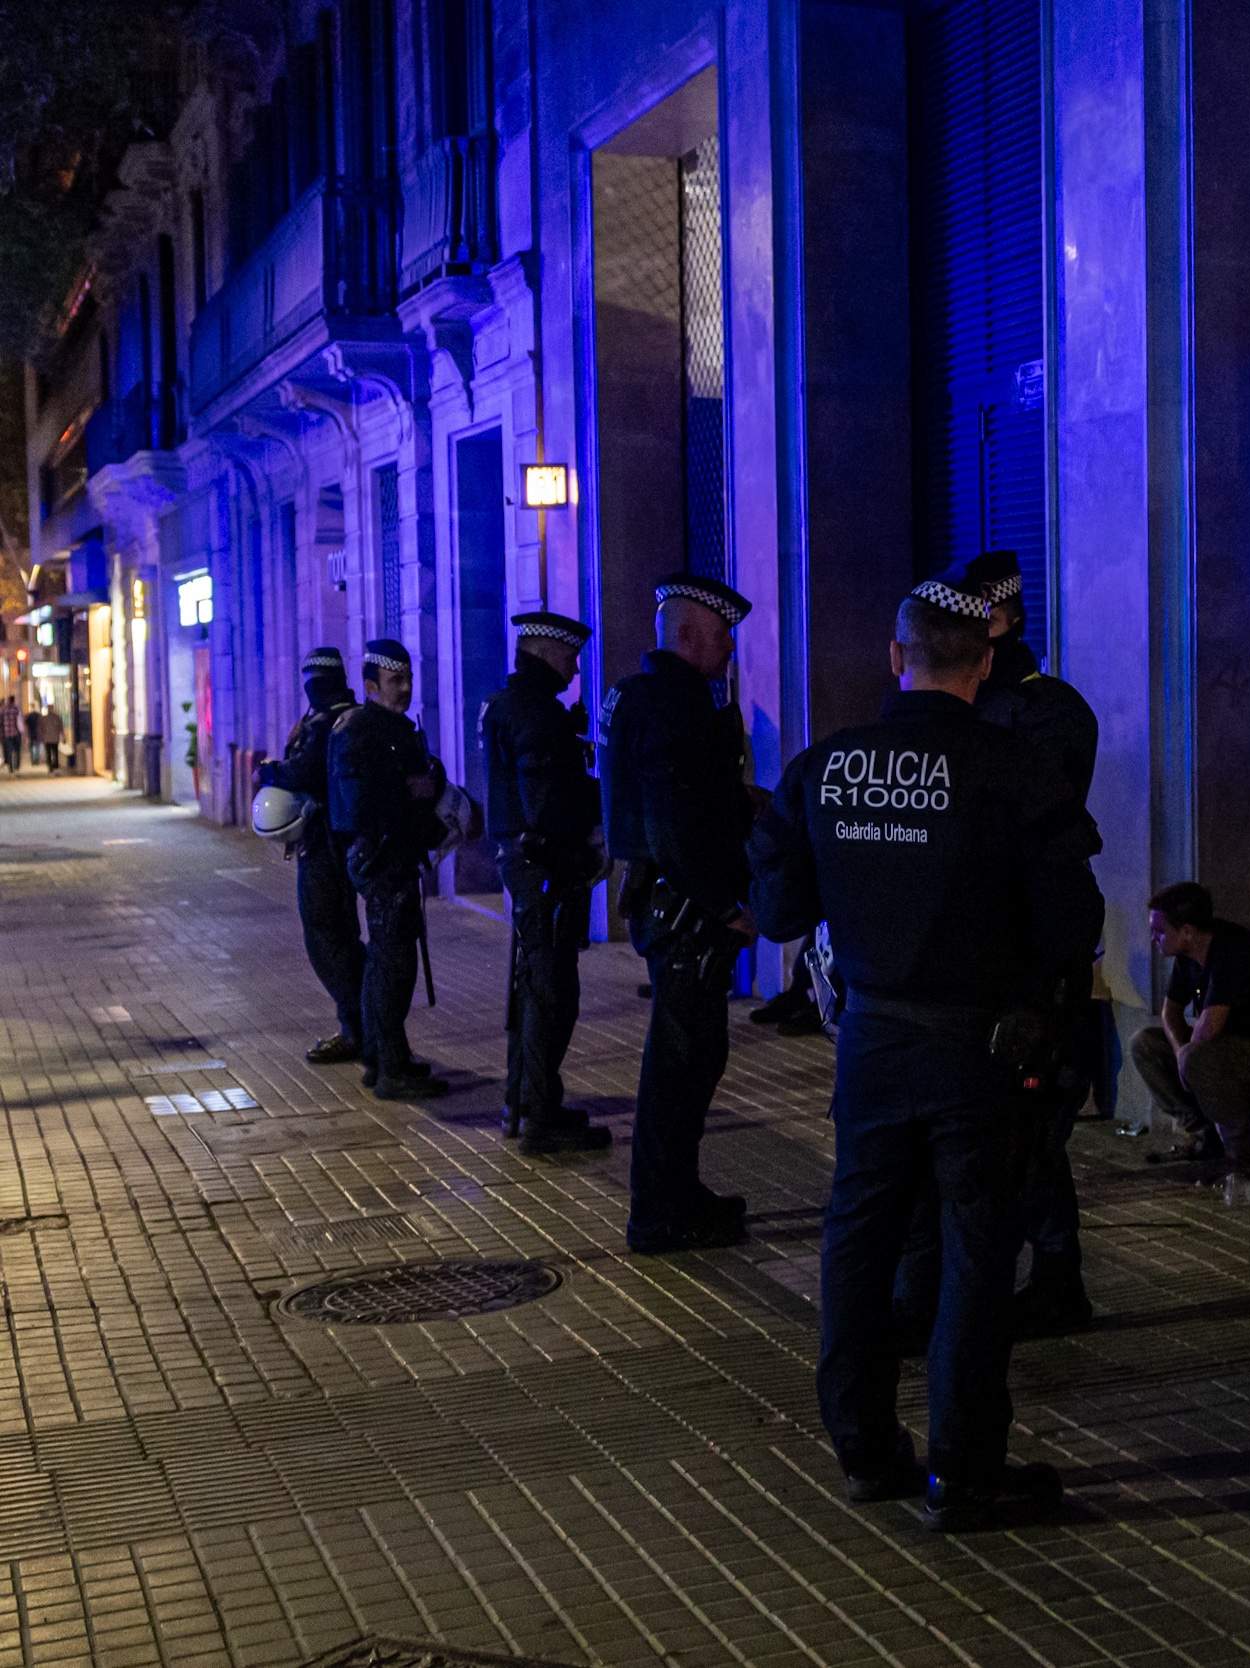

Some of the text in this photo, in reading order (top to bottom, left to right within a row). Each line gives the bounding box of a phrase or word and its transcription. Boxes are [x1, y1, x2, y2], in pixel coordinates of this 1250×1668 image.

[822, 748, 950, 788] POLICIA
[835, 819, 928, 844] Guàrdia Urbana
